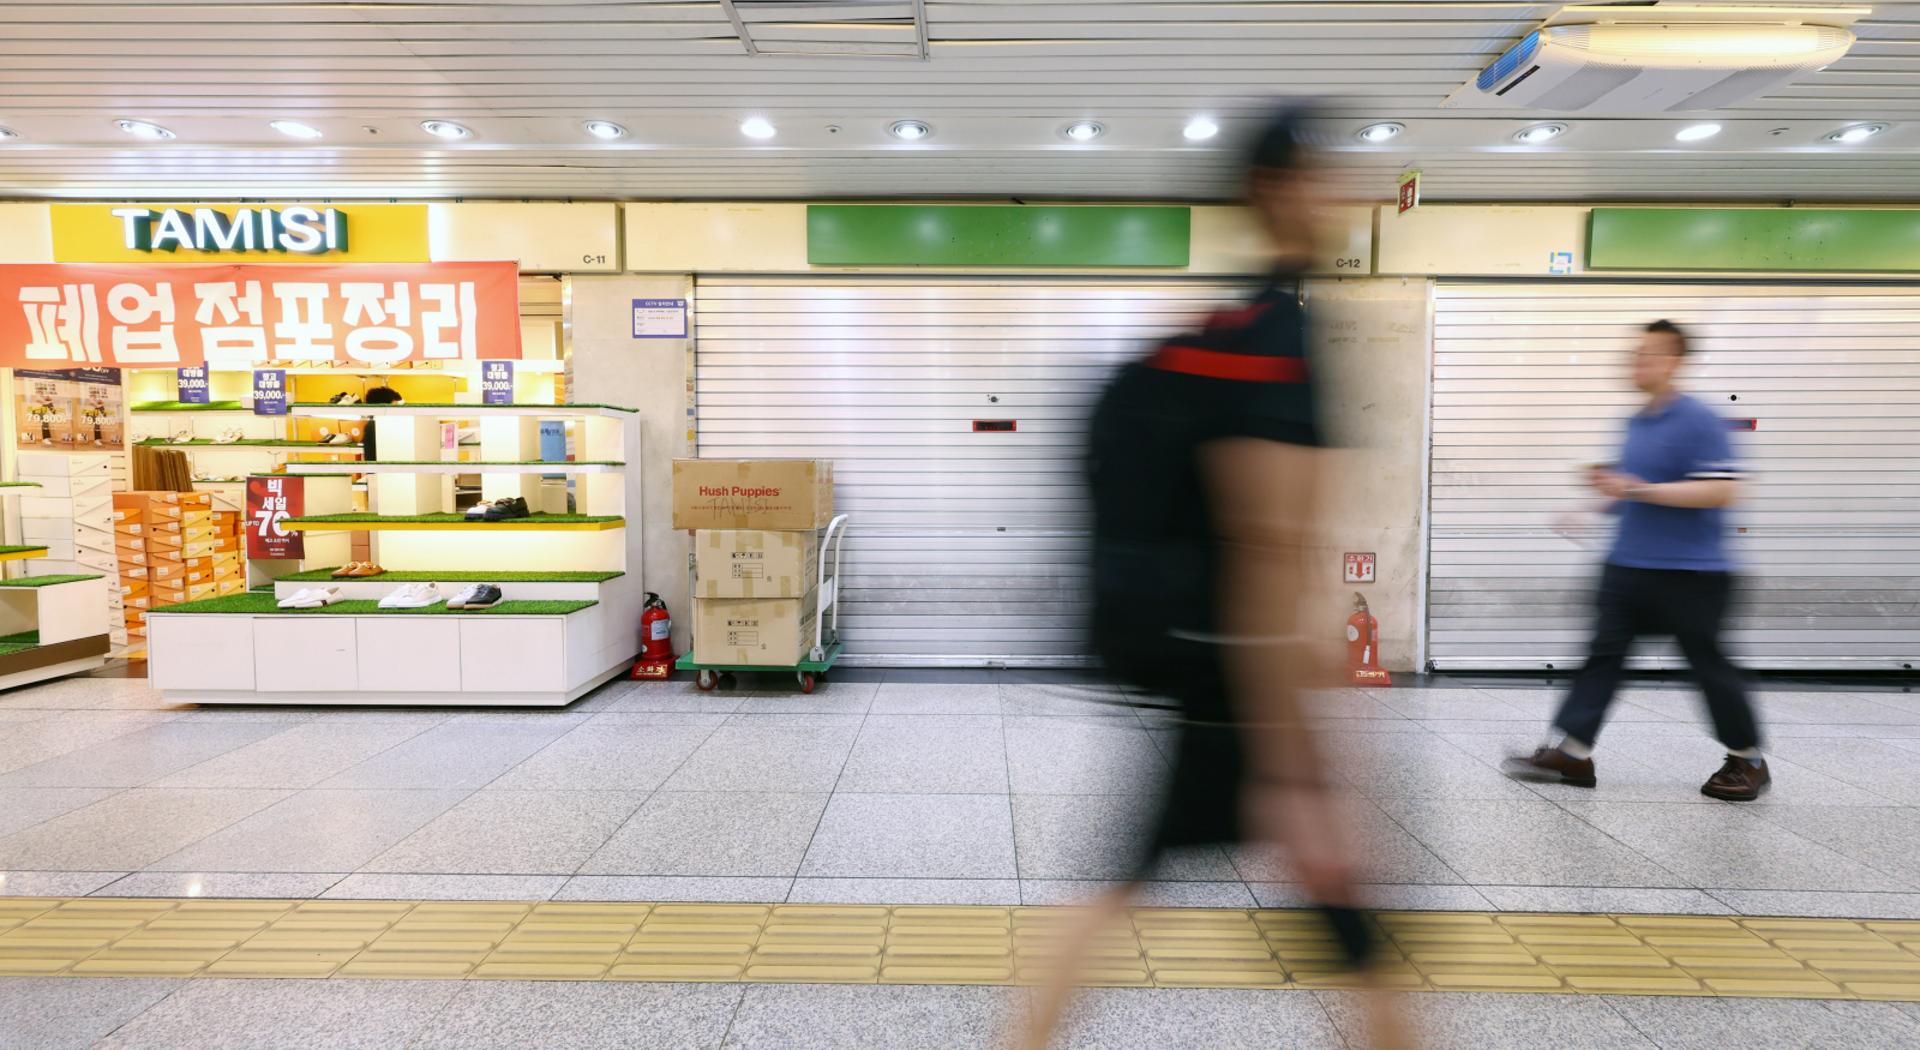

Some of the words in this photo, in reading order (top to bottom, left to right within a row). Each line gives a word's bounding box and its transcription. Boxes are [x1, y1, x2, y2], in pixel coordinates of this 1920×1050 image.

[111, 206, 340, 252] TAMISI
[583, 254, 606, 264] C-11
[1336, 258, 1361, 268] C-12
[18, 283, 180, 363] 폐업
[194, 280, 477, 363] 점포정리
[267, 479, 283, 497] 빅
[699, 486, 729, 497] Hush
[262, 496, 287, 511] 세일
